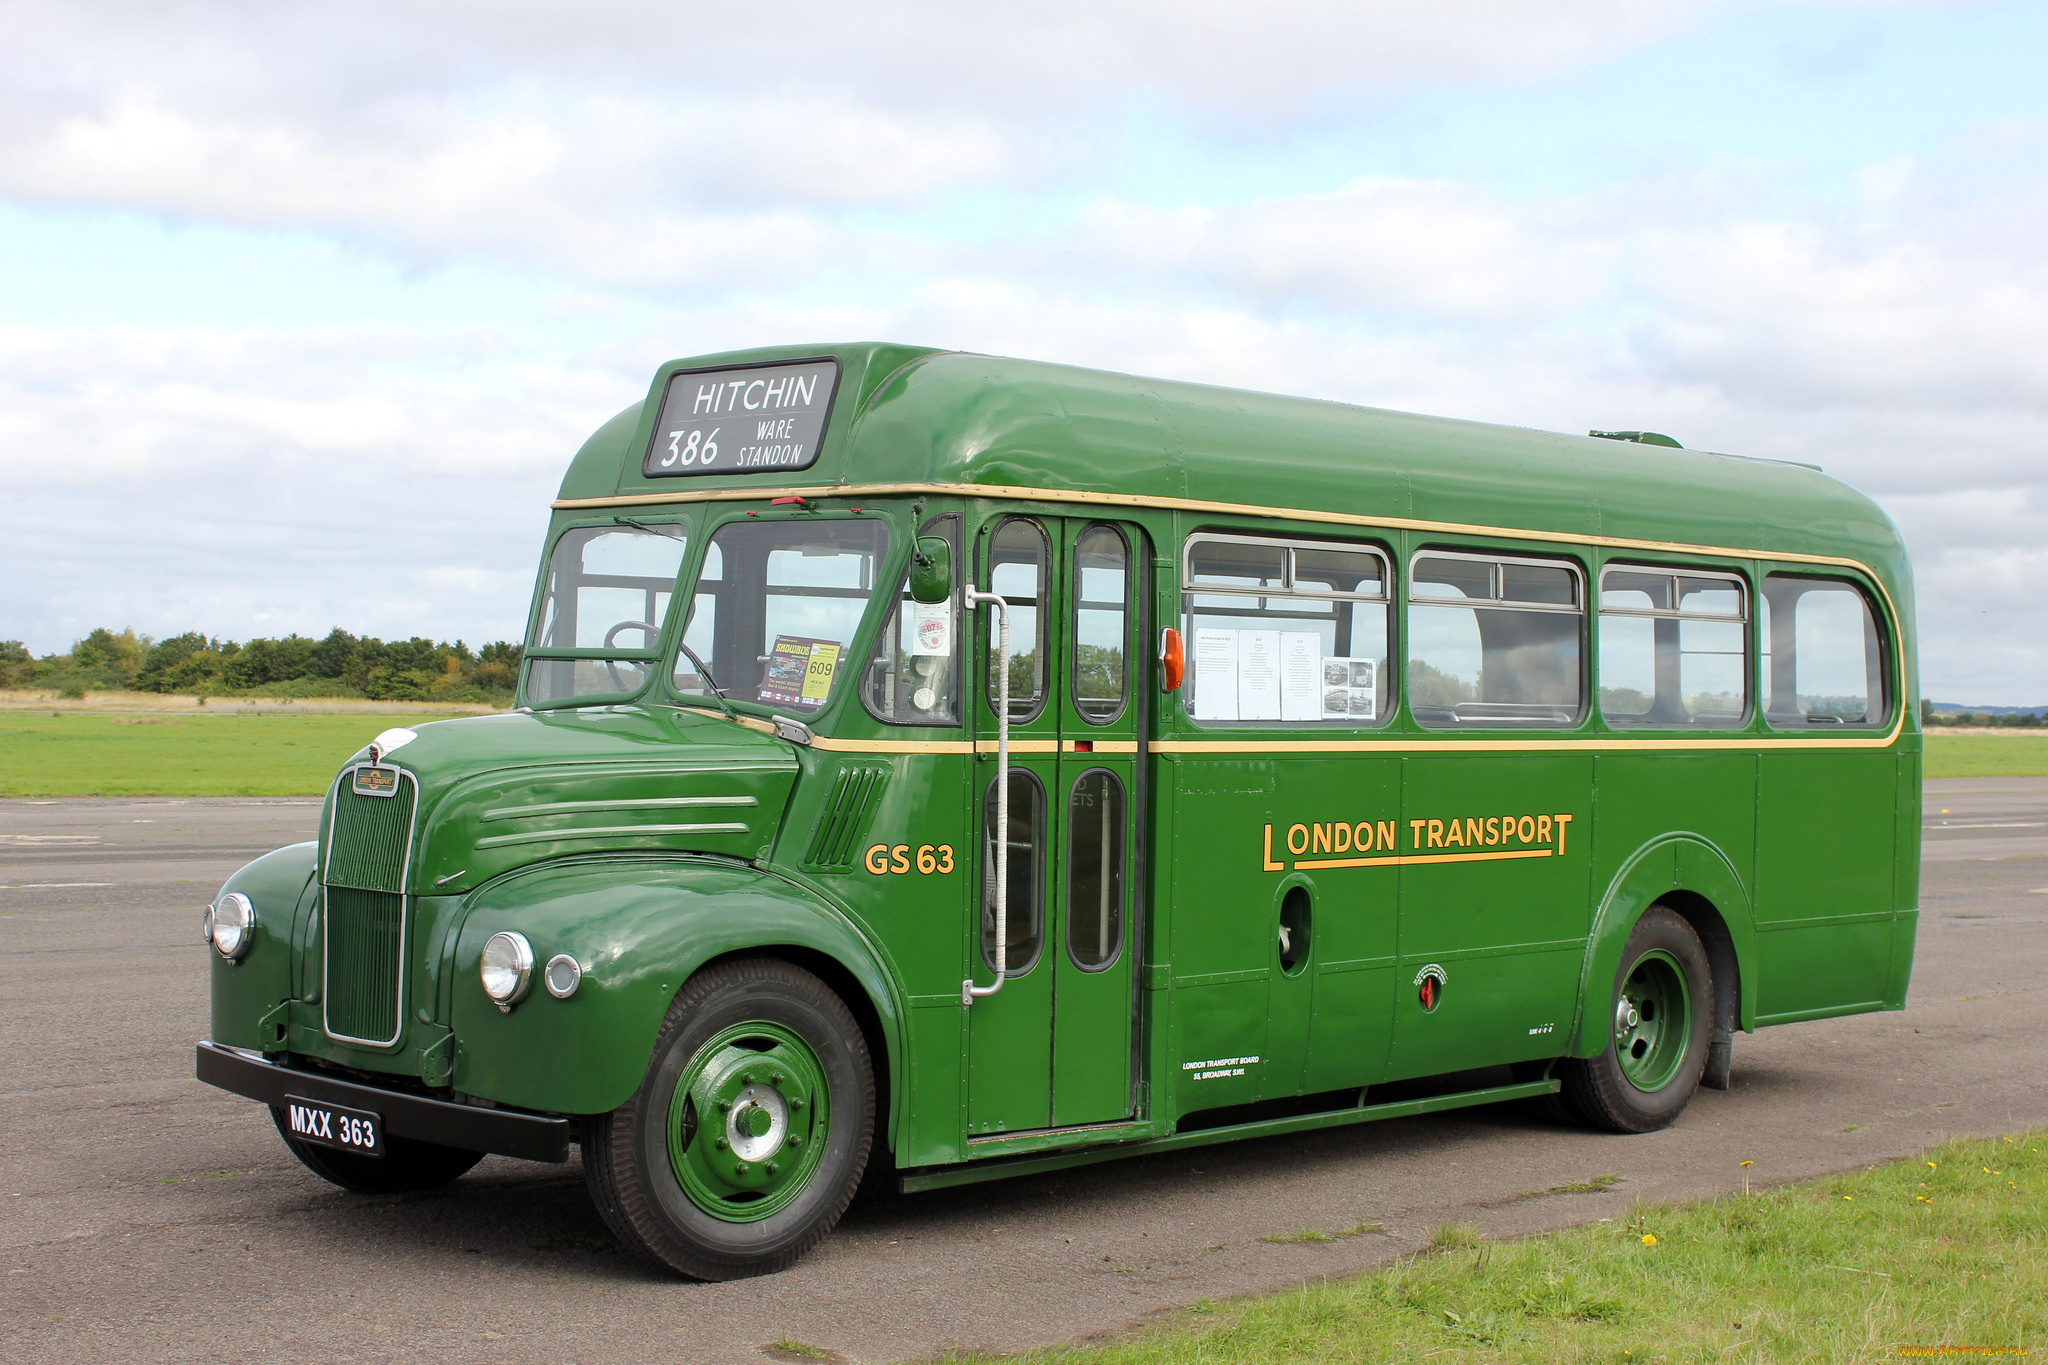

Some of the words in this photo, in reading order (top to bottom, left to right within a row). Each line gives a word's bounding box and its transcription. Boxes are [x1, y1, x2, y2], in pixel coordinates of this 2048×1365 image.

[693, 374, 818, 415] HITCHIN
[757, 418, 795, 440] WARE
[661, 427, 720, 468] 386
[737, 444, 803, 467] STANDON
[810, 662, 832, 676] 609
[1262, 819, 1396, 872] LONDON
[1410, 813, 1573, 857] TRANSPORT
[865, 843, 911, 875] GS
[916, 843, 955, 875] 63
[1182, 1062, 1206, 1070] LONDON
[1207, 1058, 1239, 1068] TRANSPORT
[1240, 1056, 1260, 1064] BOARD
[290, 1104, 333, 1140] MXX
[339, 1115, 375, 1149] 363
